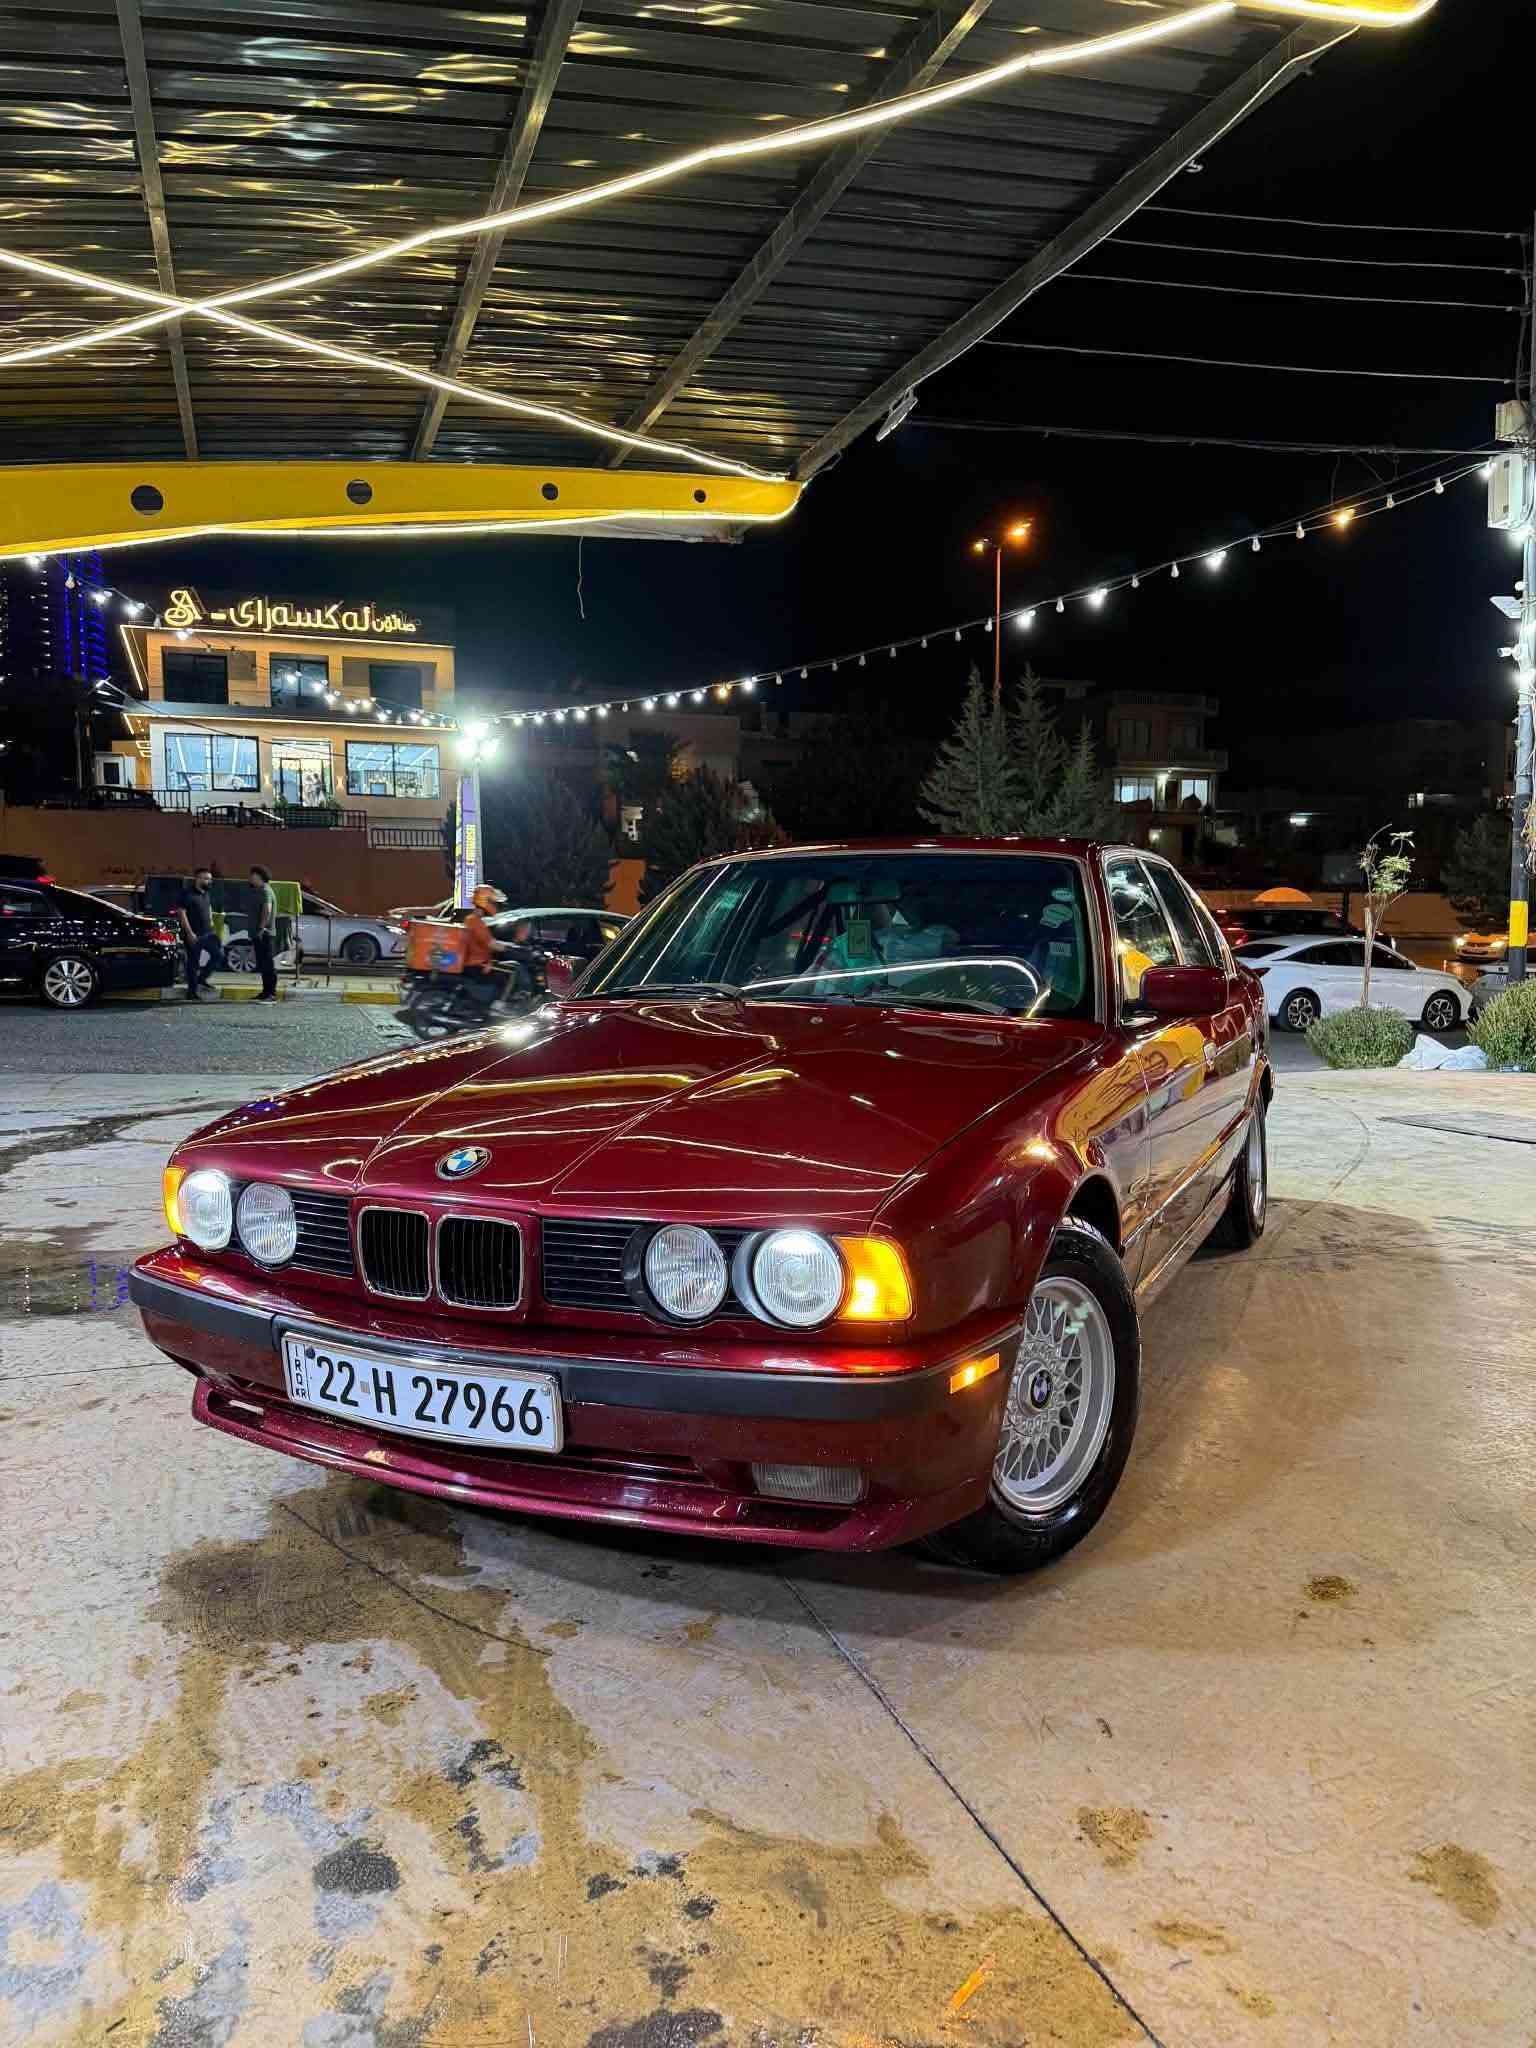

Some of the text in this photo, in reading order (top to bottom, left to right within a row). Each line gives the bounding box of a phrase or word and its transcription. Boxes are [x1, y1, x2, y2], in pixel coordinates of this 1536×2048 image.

[316, 1355, 543, 1436] 22 H 27966
